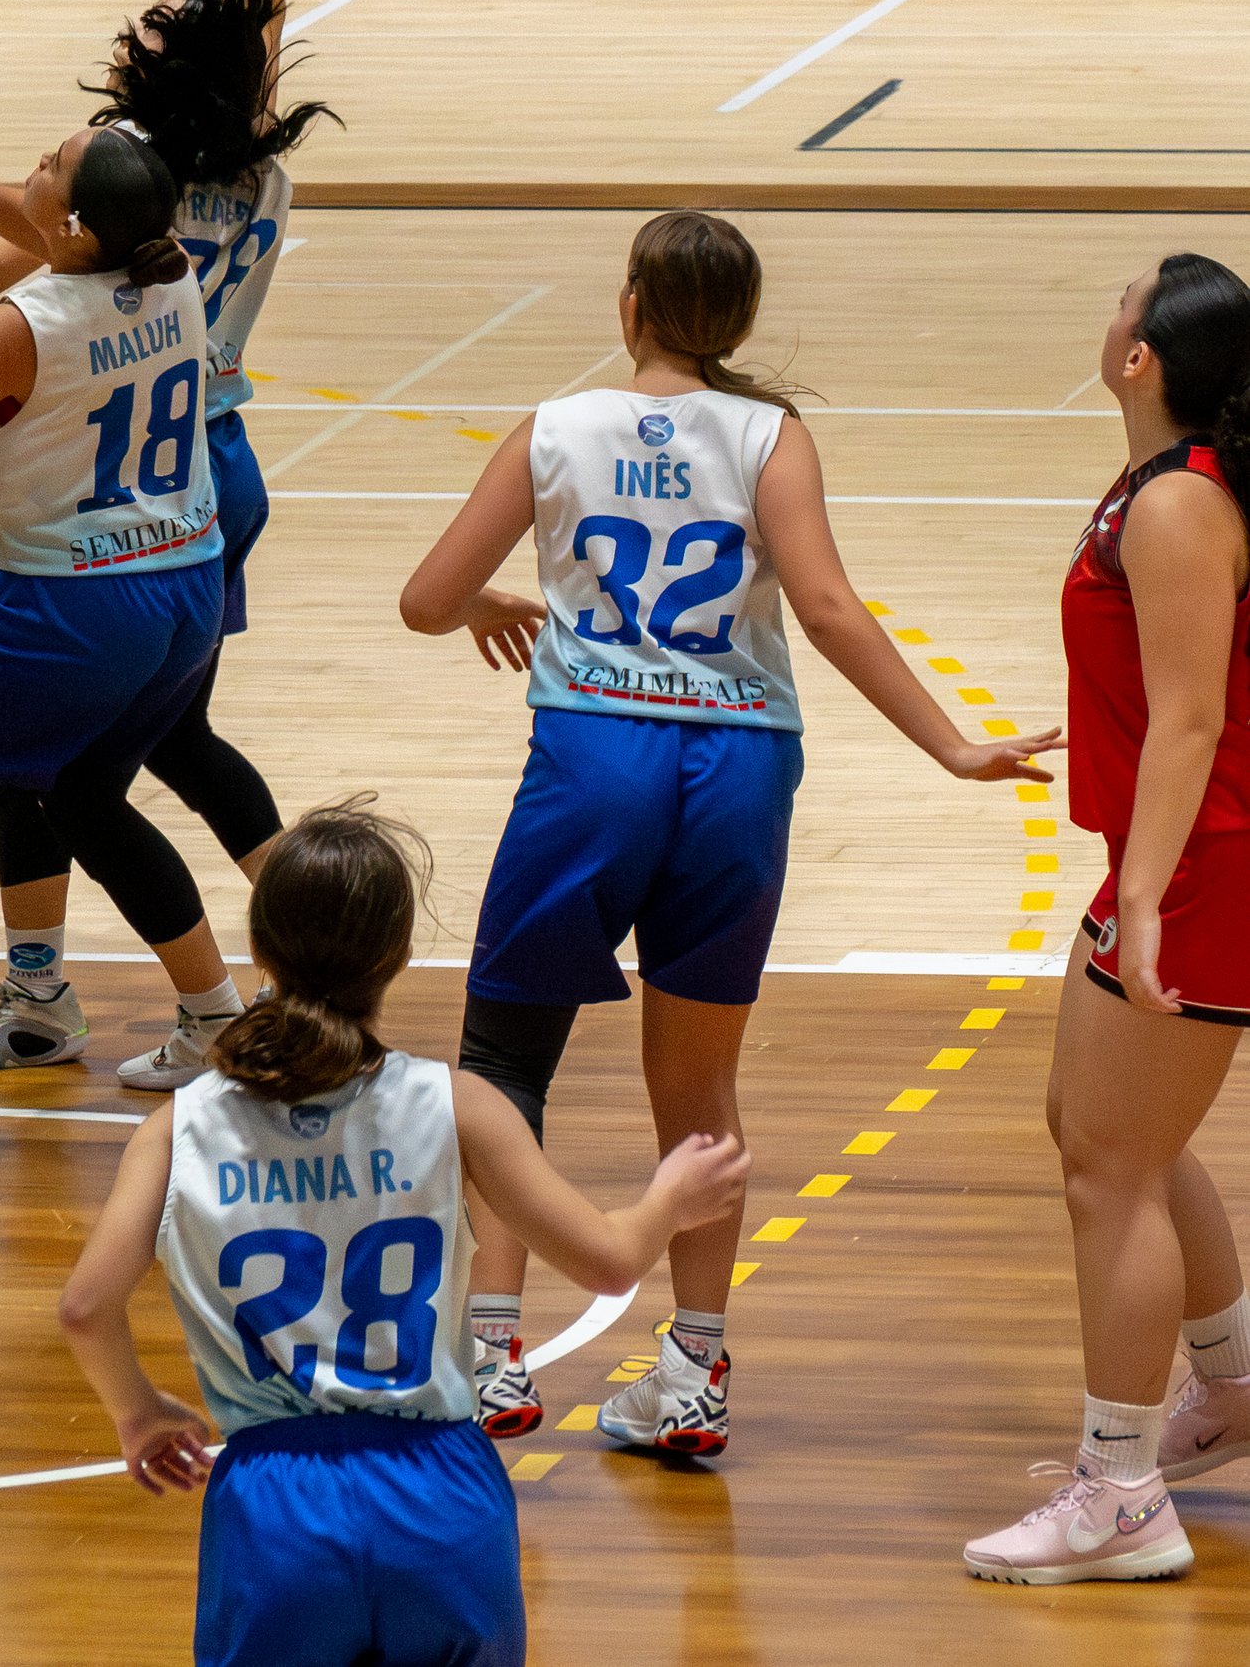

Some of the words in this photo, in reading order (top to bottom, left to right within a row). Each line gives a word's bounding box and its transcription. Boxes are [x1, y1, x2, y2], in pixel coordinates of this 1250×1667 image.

[89, 310, 182, 375] MALUH
[77, 358, 200, 515] 18
[614, 452, 692, 500] INÊS
[571, 515, 746, 655] 32
[217, 1153, 358, 1206] DIANA
[369, 1148, 413, 1196] R.
[217, 1216, 444, 1398] 28
